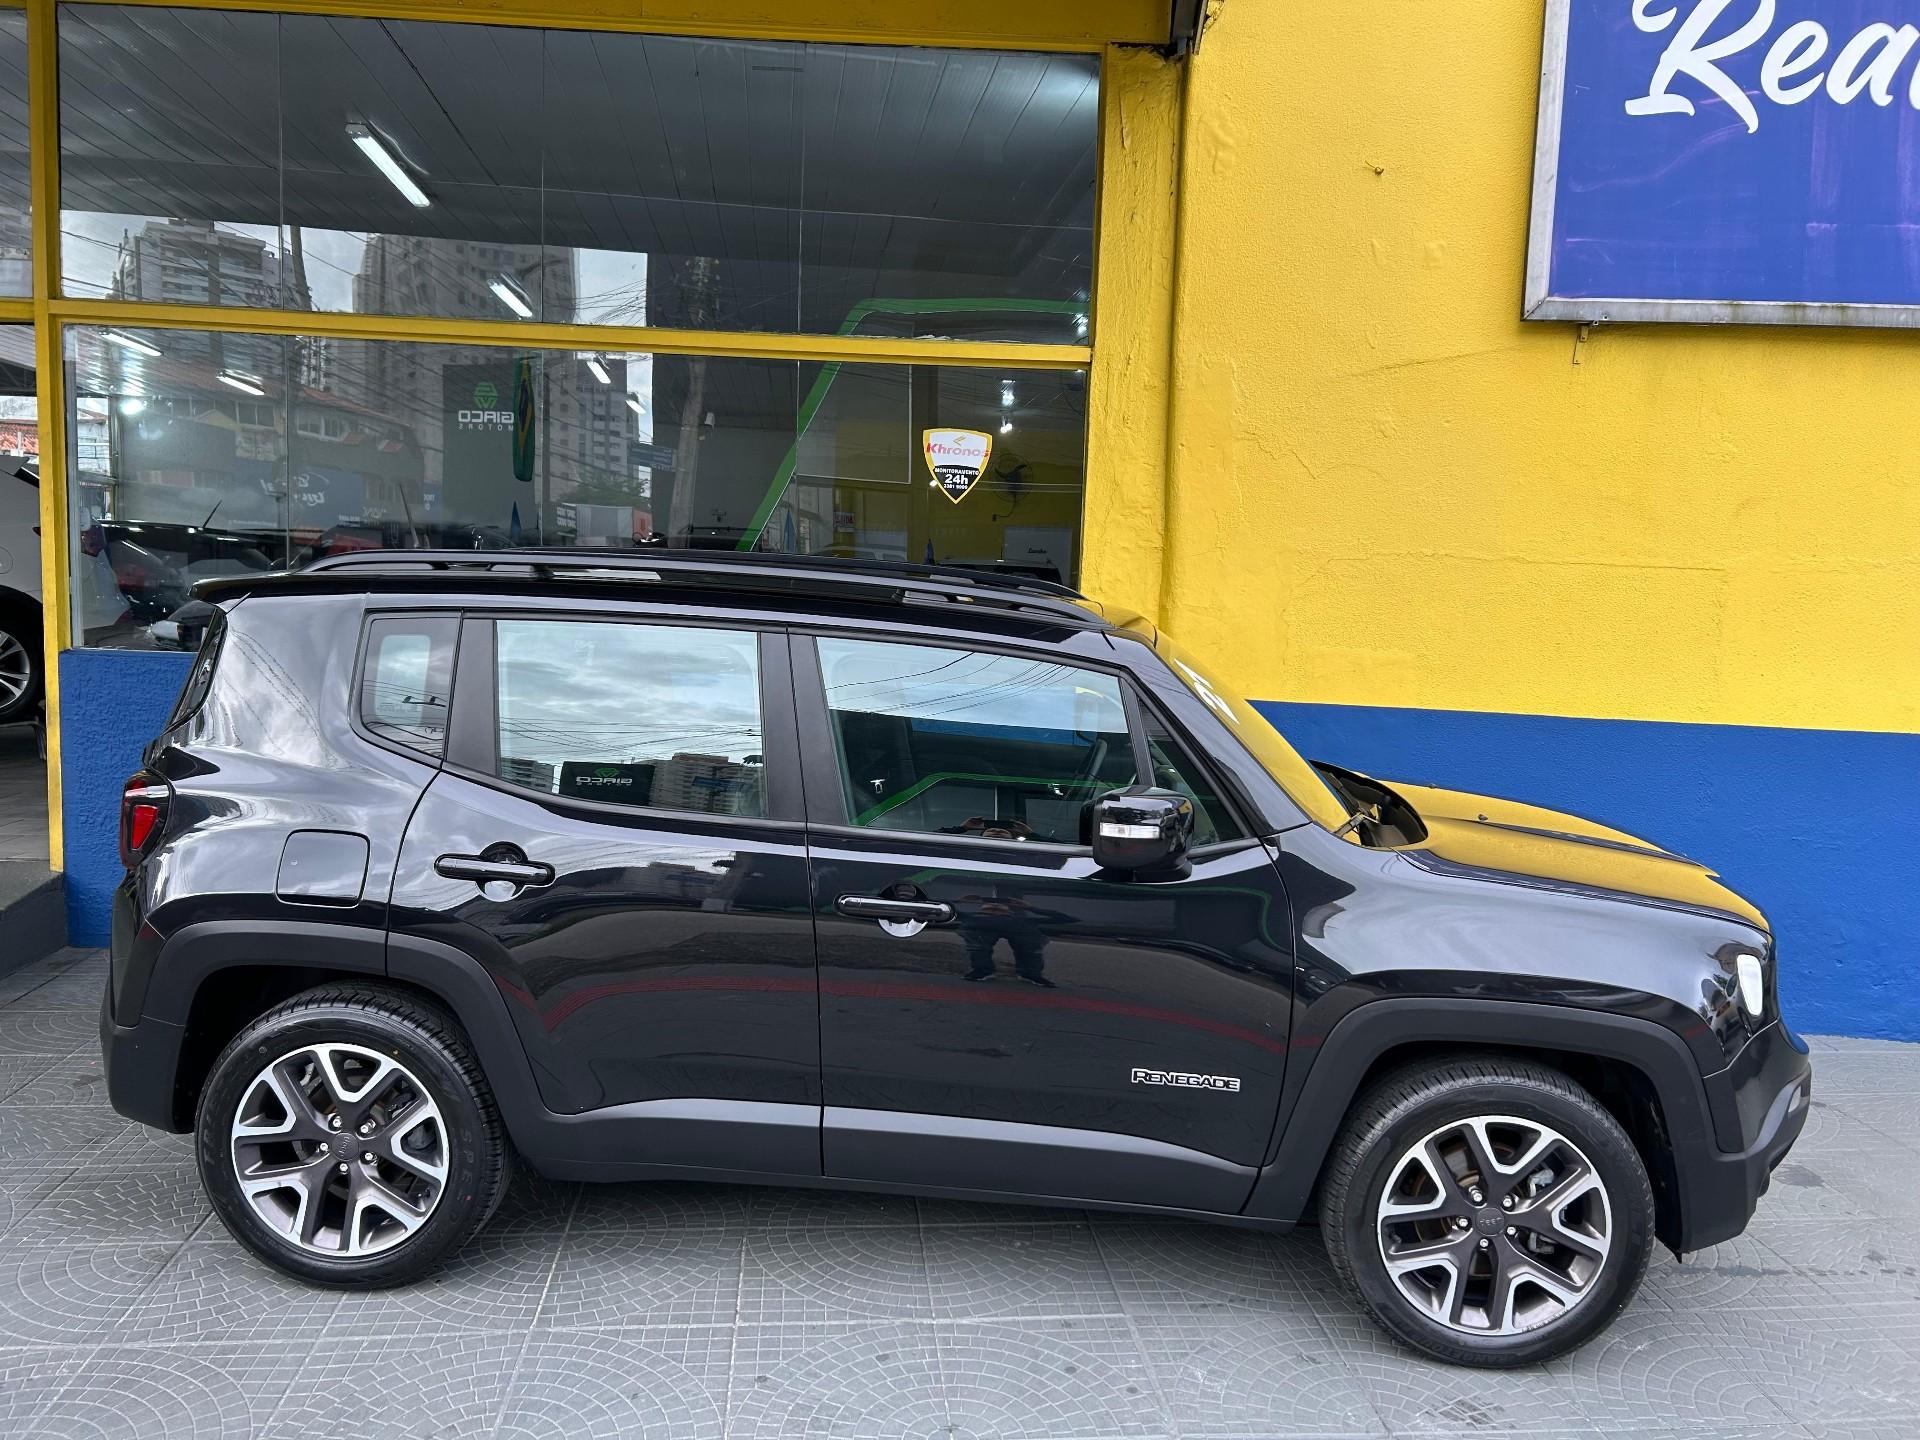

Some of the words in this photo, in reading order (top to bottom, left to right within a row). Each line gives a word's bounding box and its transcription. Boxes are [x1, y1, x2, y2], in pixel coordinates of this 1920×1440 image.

[1624, 0, 1920, 134] Rea
[926, 443, 989, 457] Khronos
[944, 474, 969, 485] 24h
[1131, 1068, 1241, 1093] RENEGADE
